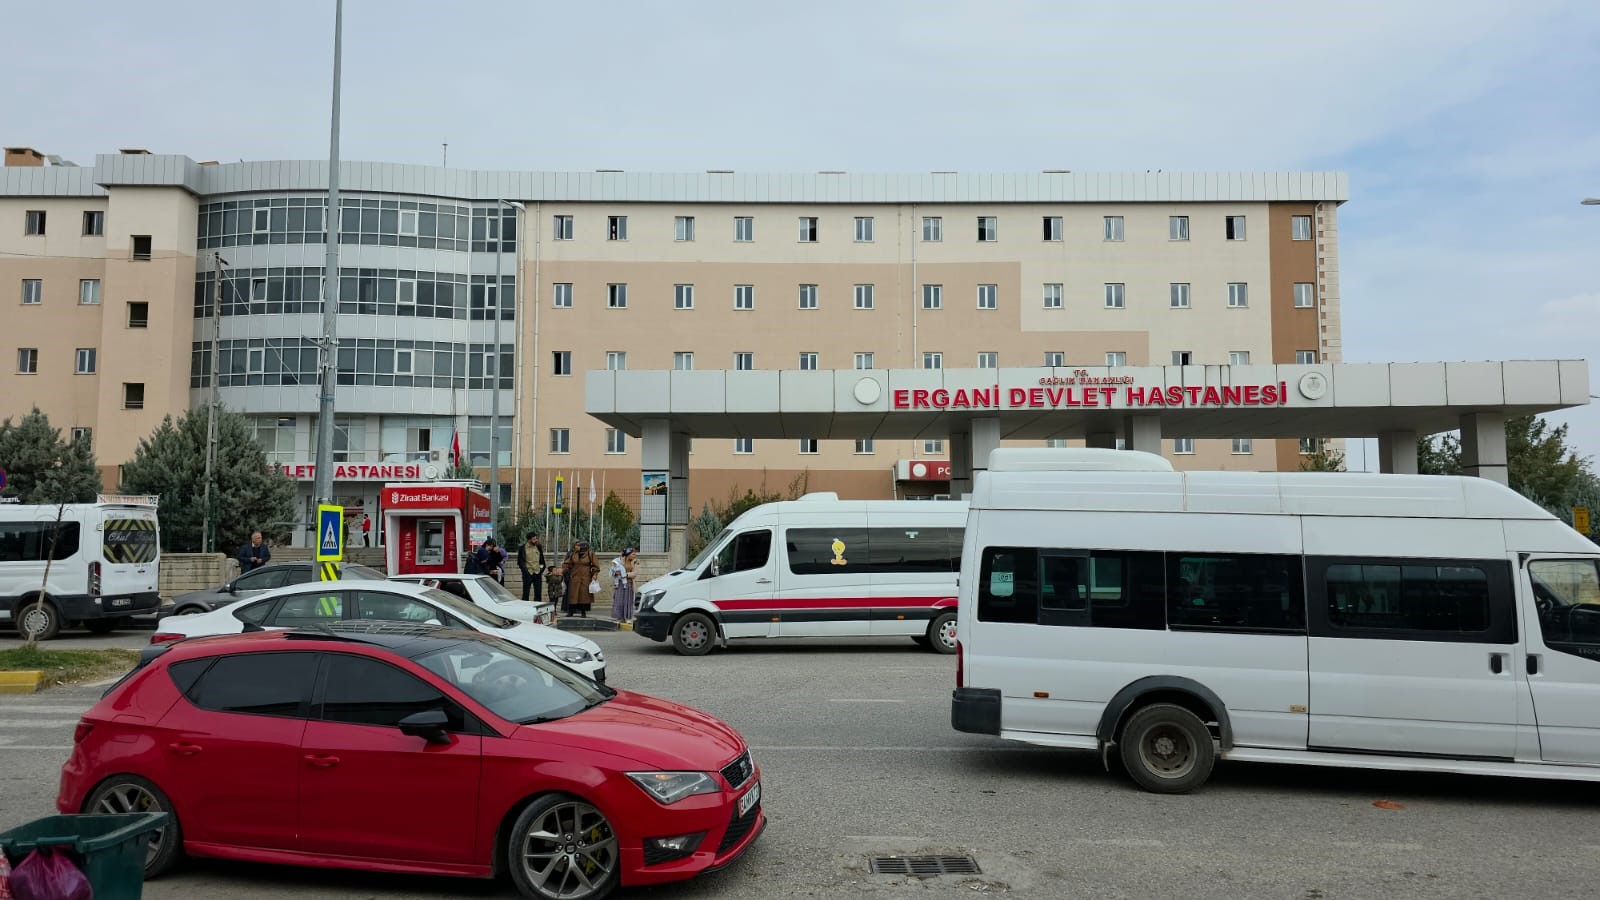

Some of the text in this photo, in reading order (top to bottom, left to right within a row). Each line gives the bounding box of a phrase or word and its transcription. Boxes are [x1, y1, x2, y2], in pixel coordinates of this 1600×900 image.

[894, 381, 1287, 409] ERGANİ DEVLET HASTANESİ
[335, 464, 420, 479] ASTANESİ
[400, 493, 449, 502] Ziraat Bankası
